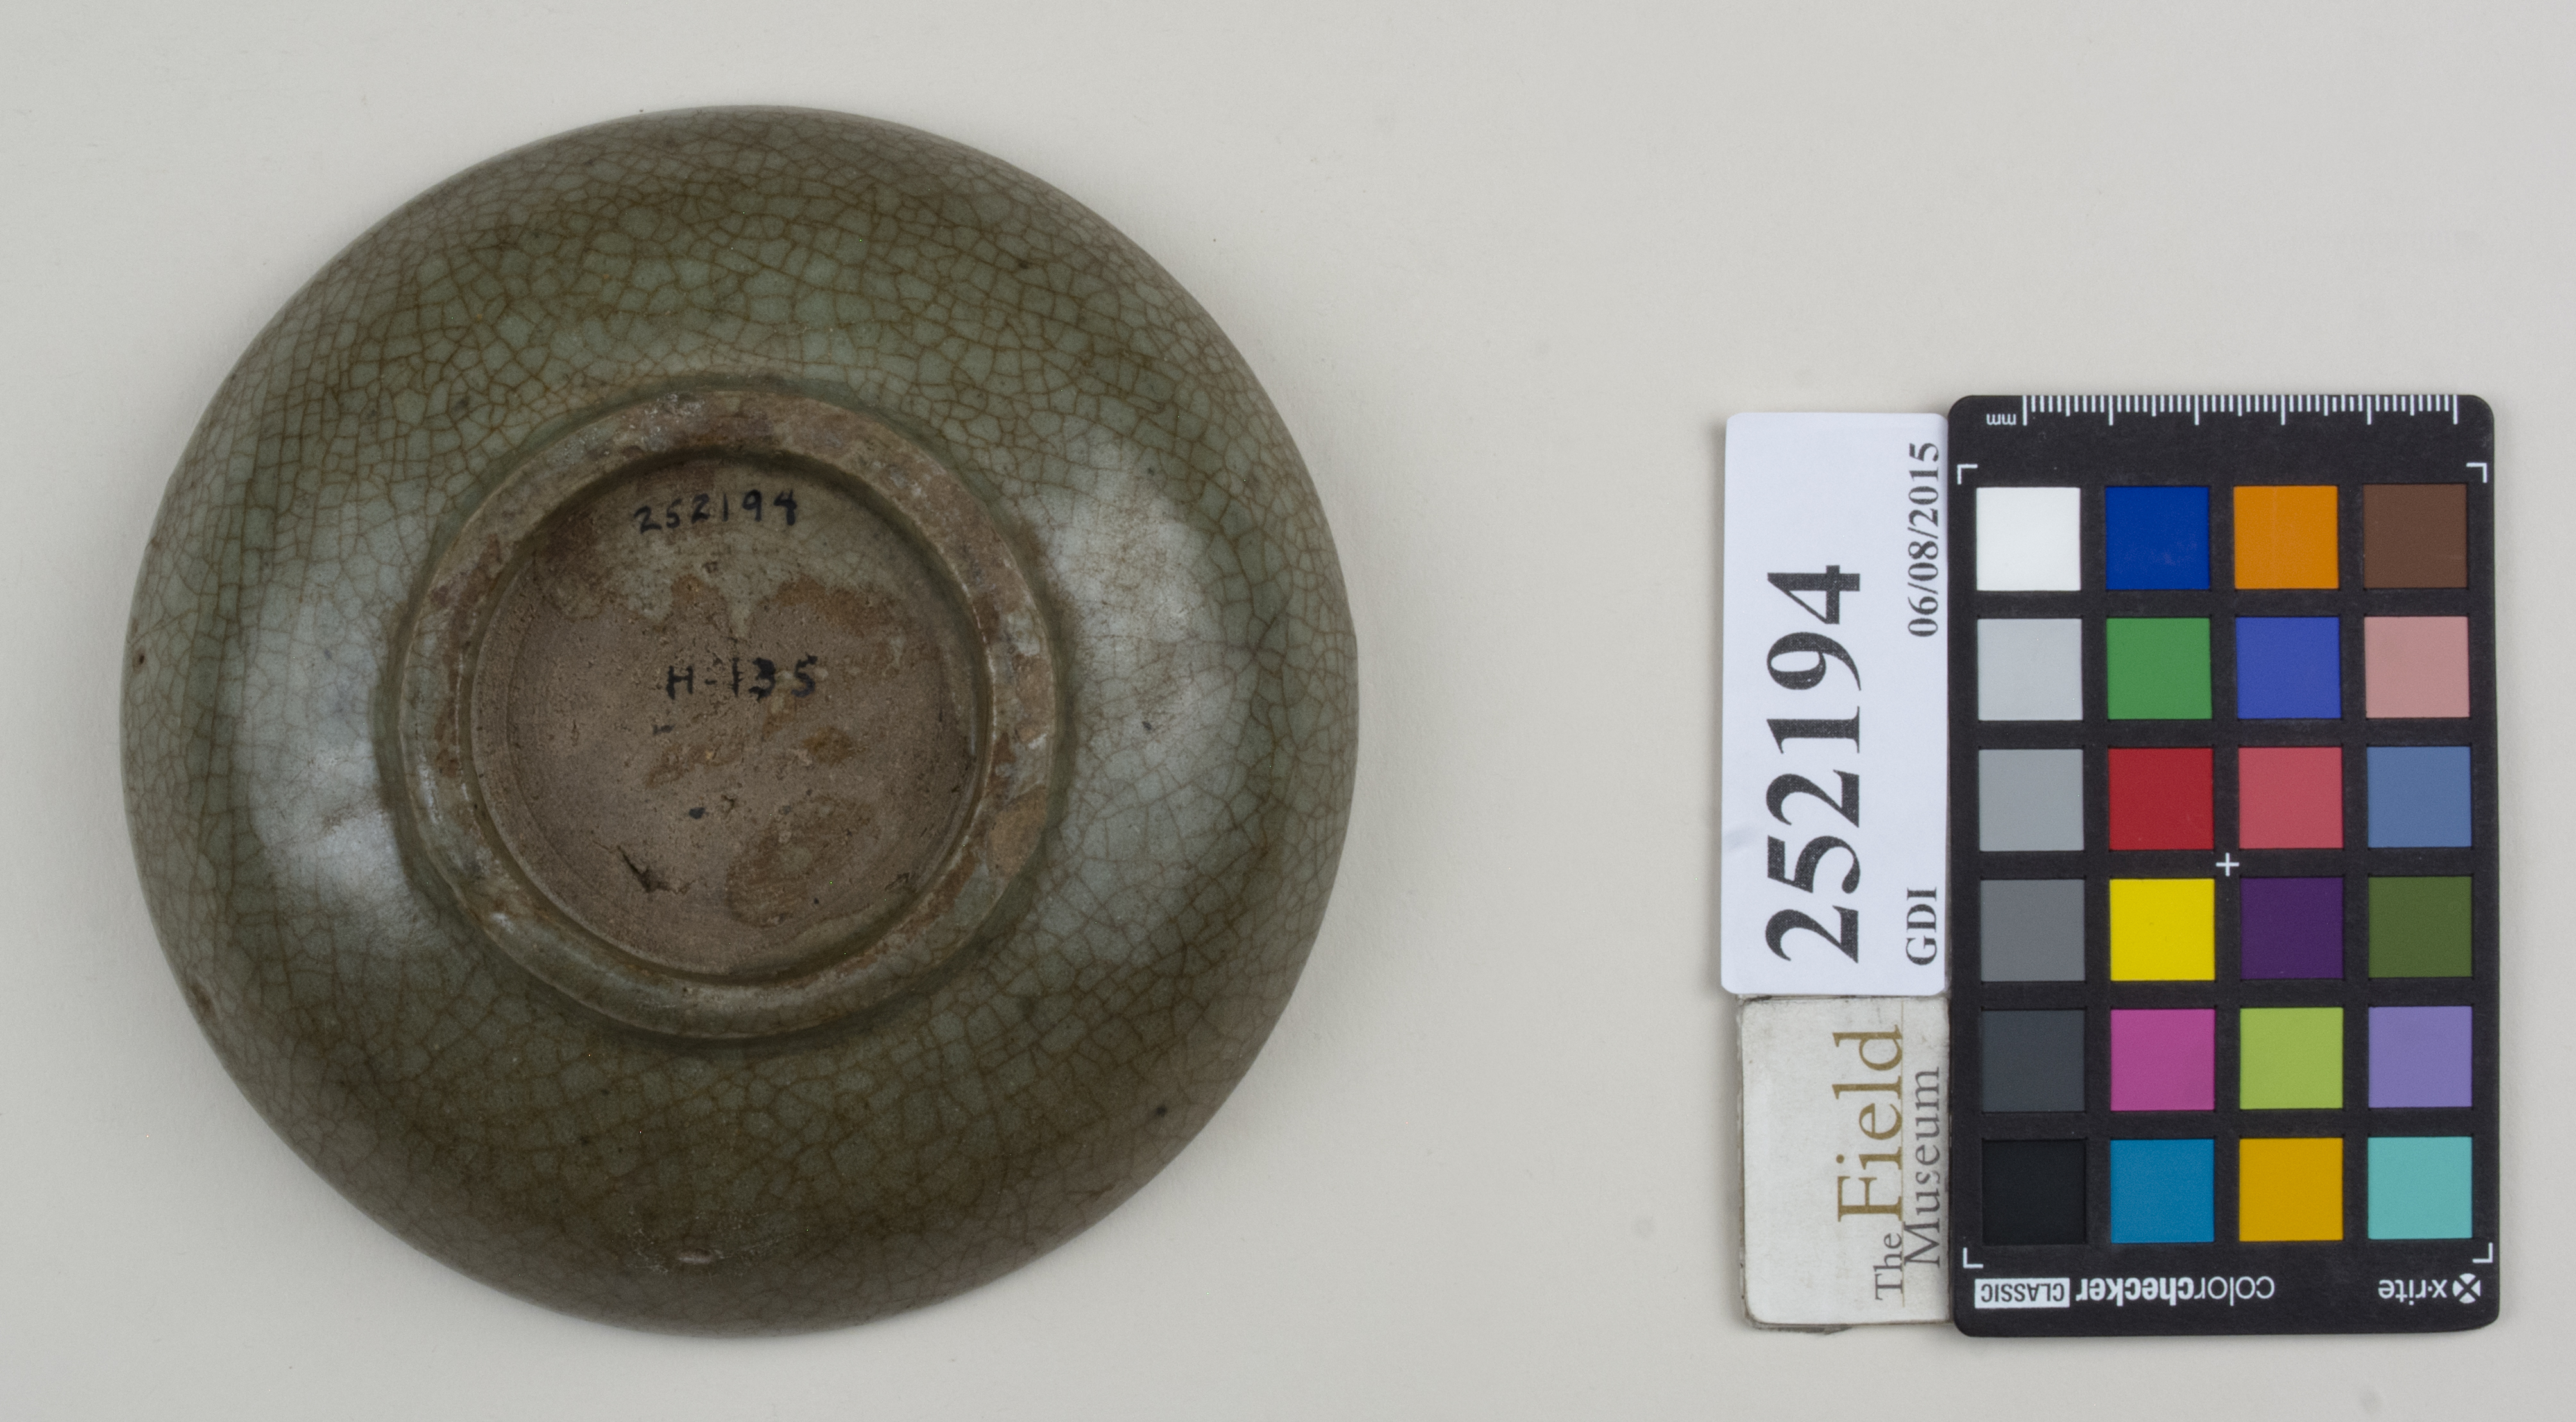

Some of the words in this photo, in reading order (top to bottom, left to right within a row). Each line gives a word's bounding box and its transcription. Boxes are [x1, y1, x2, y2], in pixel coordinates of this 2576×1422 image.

[1986, 414, 2017, 425] mm
[634, 489, 798, 534] 252194
[1907, 443, 1940, 637] 06/08/2015
[1765, 565, 1861, 964] 252194
[1906, 886, 1937, 966] GDI
[1832, 1024, 1904, 1222] Field
[1903, 1066, 1940, 1268] Museum
[1873, 1232, 1904, 1301] The
[1981, 1285, 2065, 1302] CLASSIC
